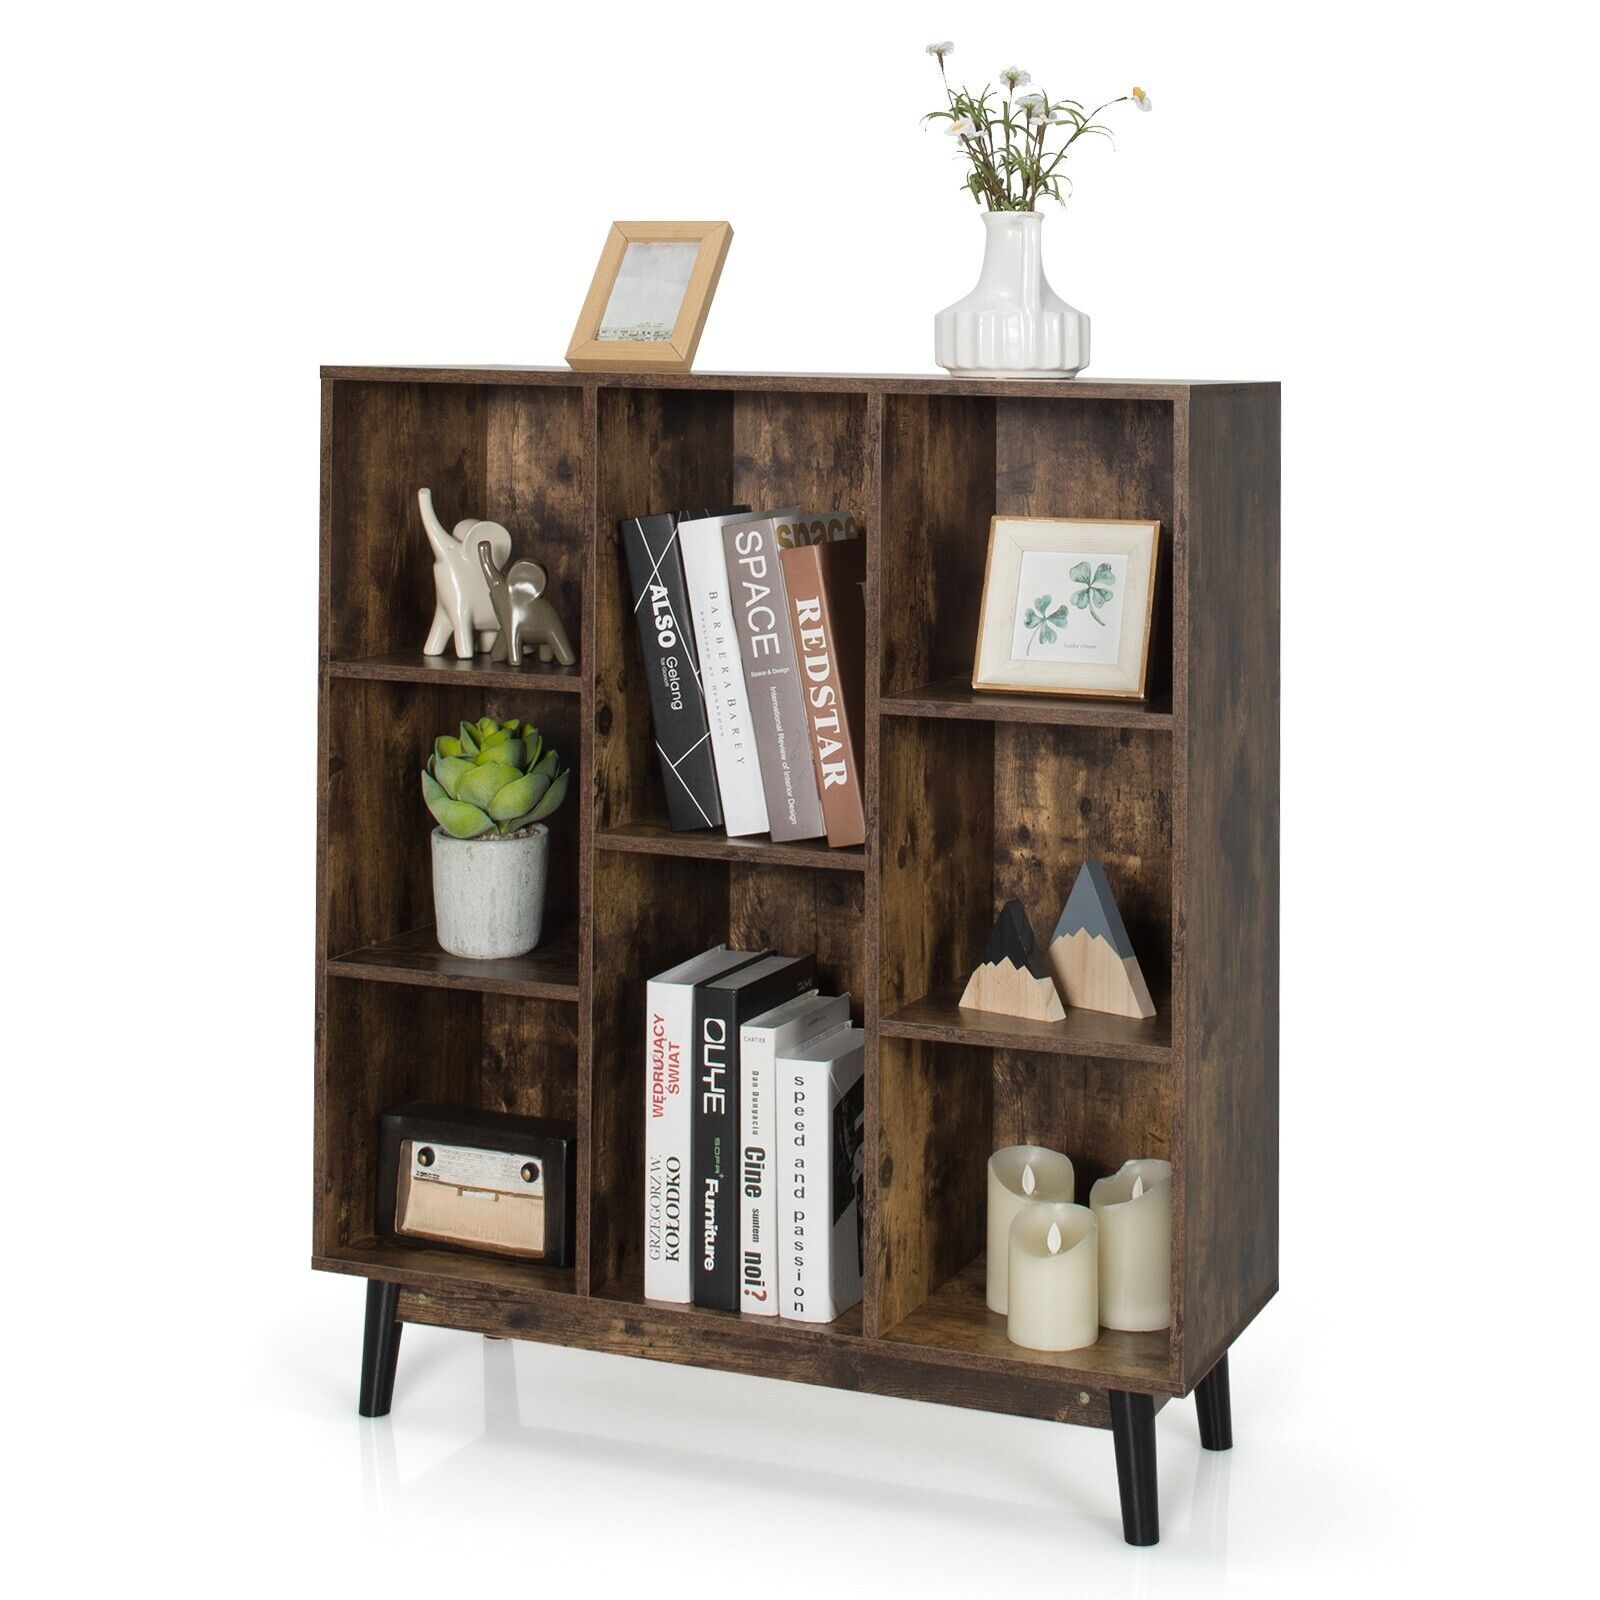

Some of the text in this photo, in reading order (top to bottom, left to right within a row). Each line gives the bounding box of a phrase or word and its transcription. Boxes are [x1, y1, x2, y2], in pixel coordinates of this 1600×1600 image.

[650, 585, 677, 648] ALSO
[735, 530, 780, 658] SPACE
[666, 656, 683, 710] Gelang
[795, 596, 847, 789] REDSTAR
[770, 686, 797, 825] International Review of Interior Design
[652, 1013, 666, 1118] WĘDRUJĄCY
[665, 1041, 680, 1095] ŚWIAT
[649, 1175, 662, 1260] GRZEGORZ
[665, 1156, 681, 1262] KOŁODKO
[744, 1146, 766, 1198] Cine
[794, 1076, 806, 1313] speed and passion
[704, 1178, 719, 1271] Furniture
[752, 1208, 760, 1243] suntem
